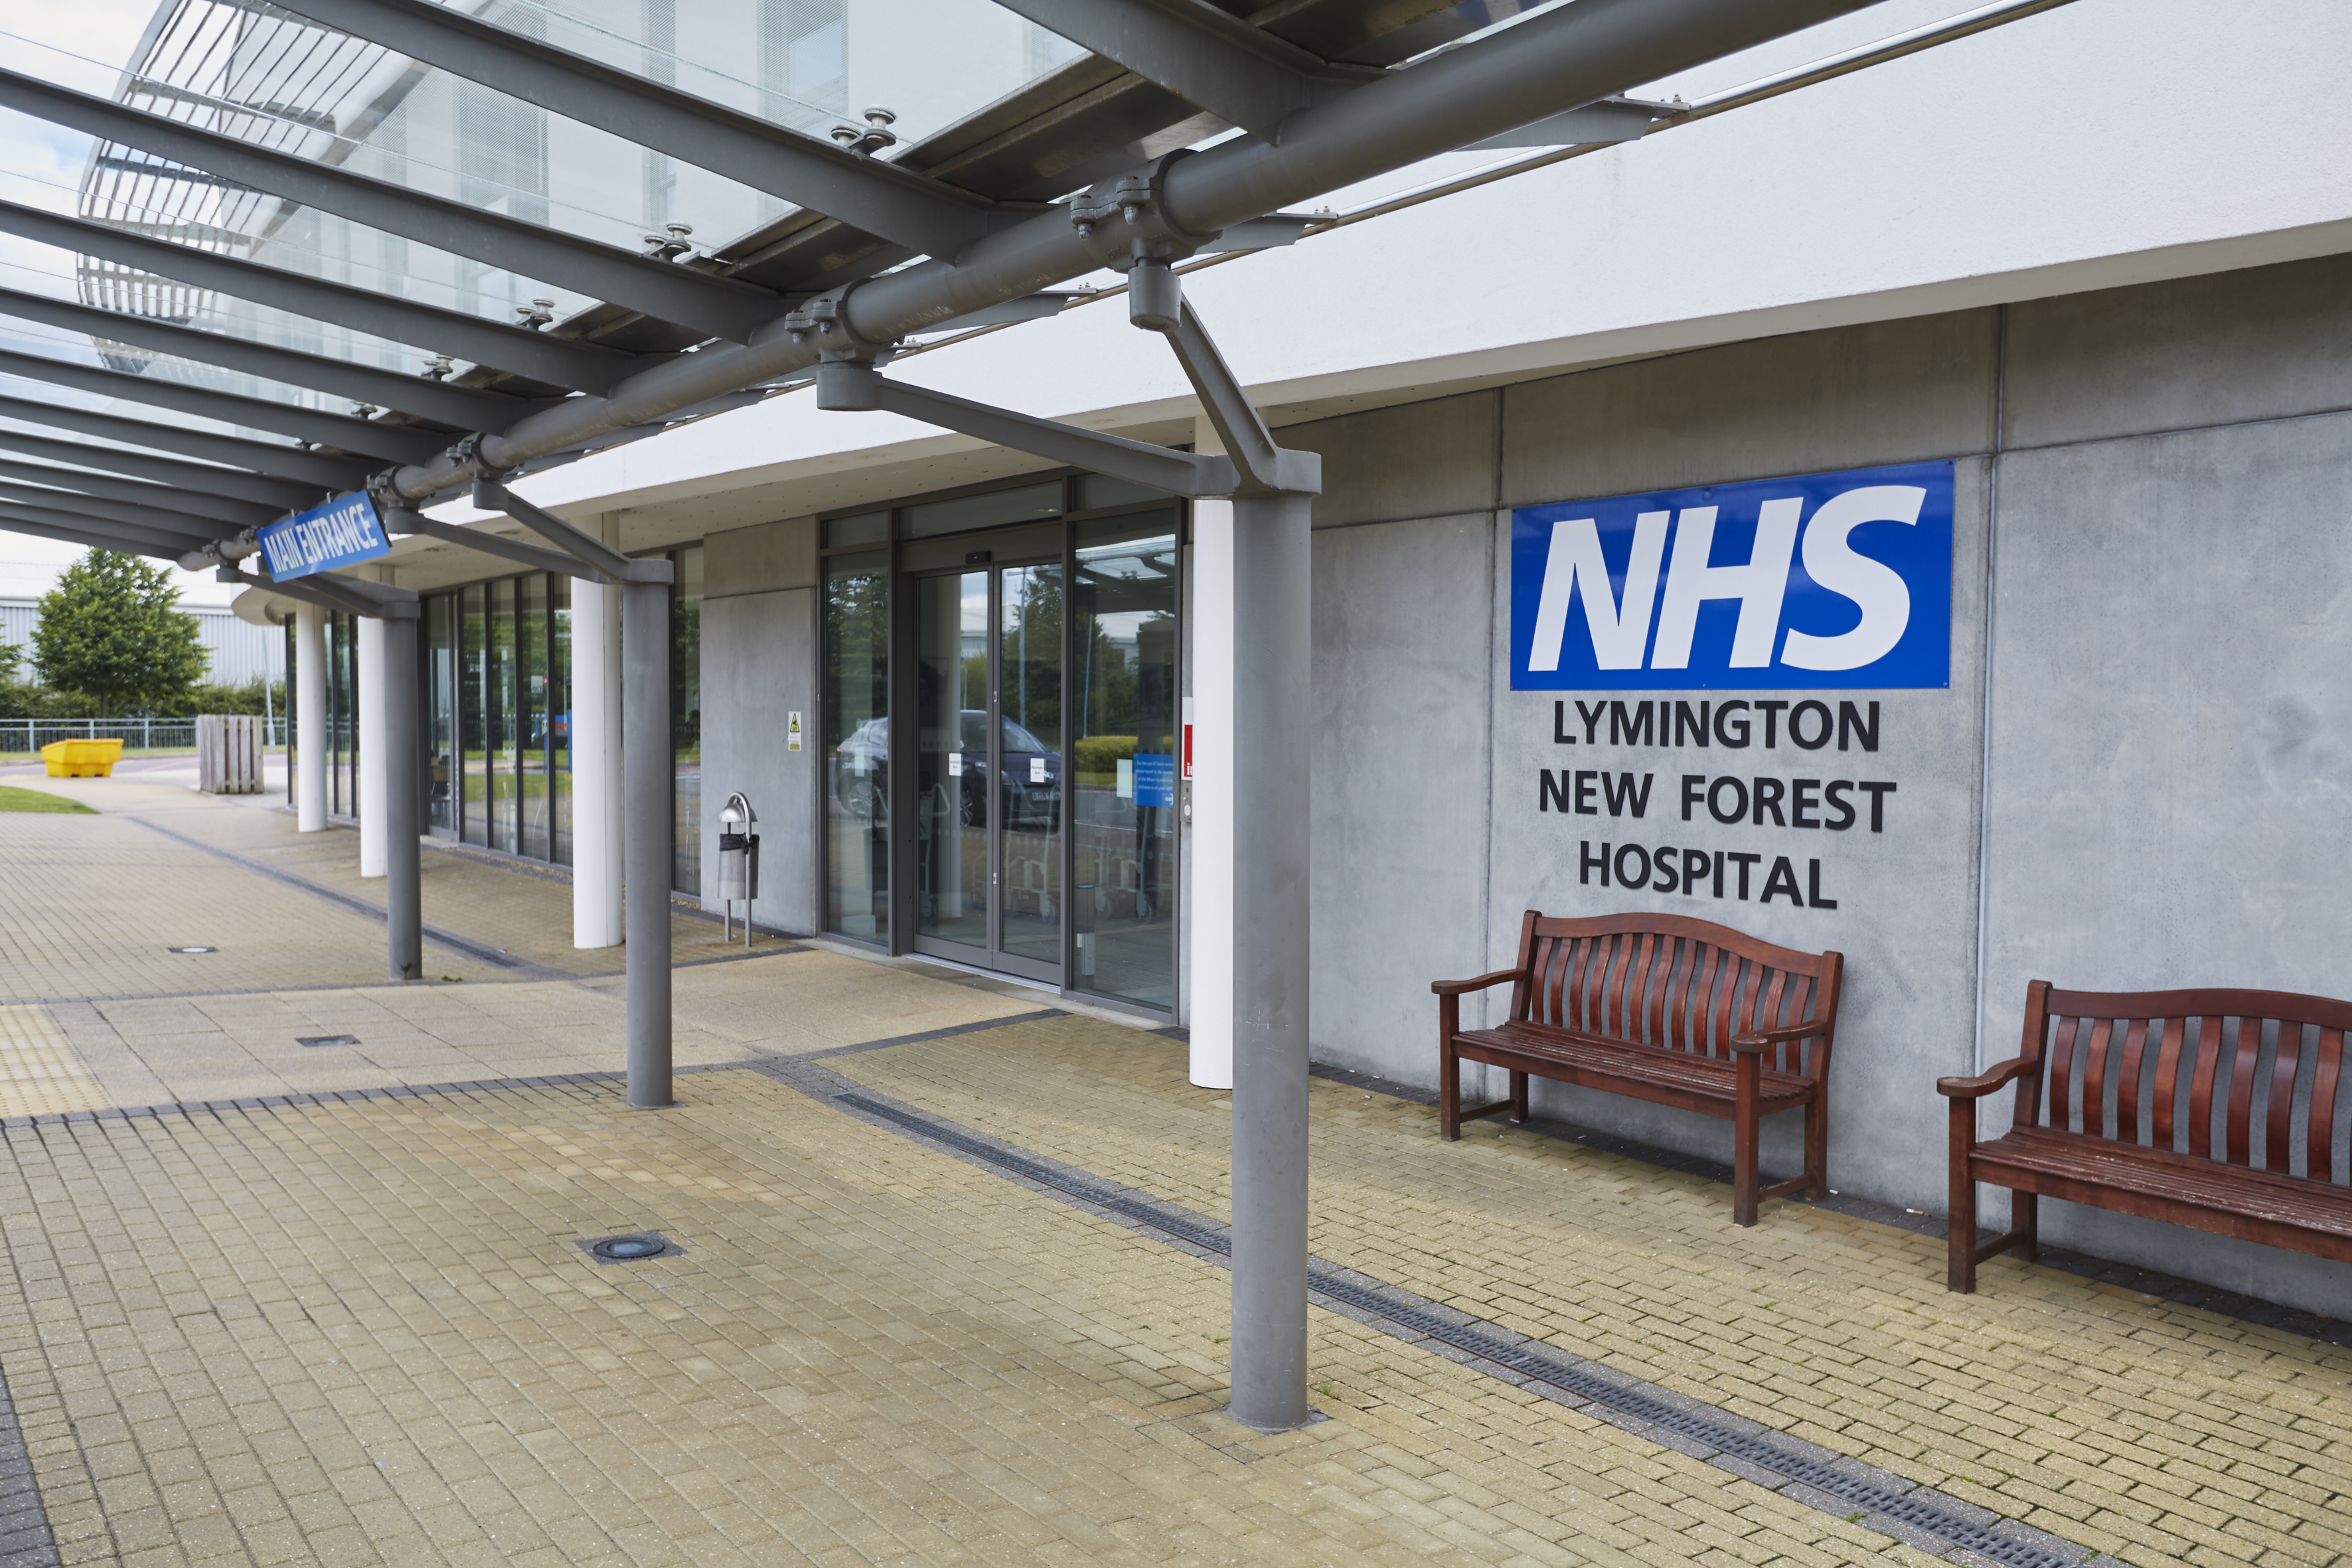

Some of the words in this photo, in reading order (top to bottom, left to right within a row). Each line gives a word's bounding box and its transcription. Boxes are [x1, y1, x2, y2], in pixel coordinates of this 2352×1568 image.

[264, 528, 305, 574] MAIN
[295, 503, 378, 564] ENTRANCE
[1528, 485, 1926, 671] NHS
[1553, 700, 1880, 751] LYMINGTON
[1539, 769, 1654, 817] NEW
[1681, 774, 1897, 832] FOREST
[1580, 840, 1838, 909] HOSPITAL
